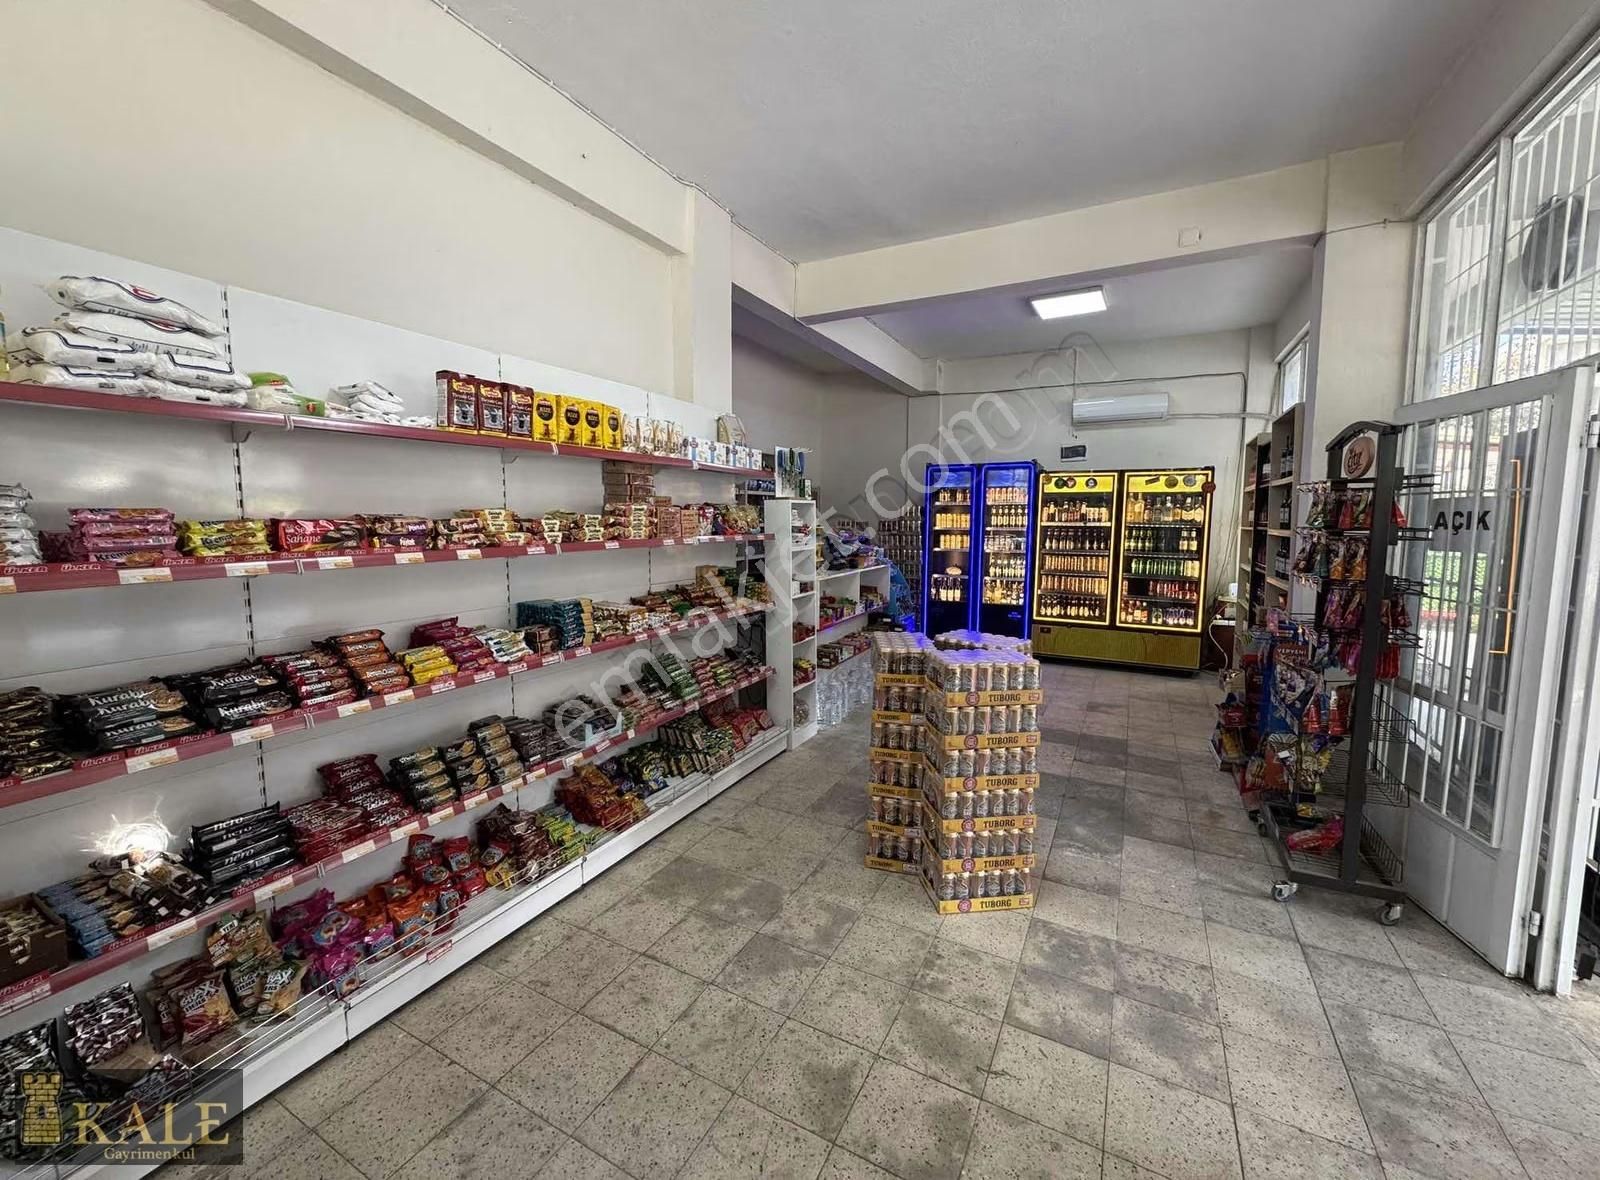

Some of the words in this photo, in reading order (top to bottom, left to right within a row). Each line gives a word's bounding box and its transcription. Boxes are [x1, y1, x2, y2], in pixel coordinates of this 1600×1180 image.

[1434, 510, 1491, 536] AÇIK
[988, 694, 1021, 702] TUBORG
[986, 735, 1019, 746] TUBORG
[986, 777, 1018, 787] TUBORG
[984, 819, 1016, 829] TUBORG
[983, 858, 1016, 869] TUBORG
[980, 898, 1012, 909] TUBORG
